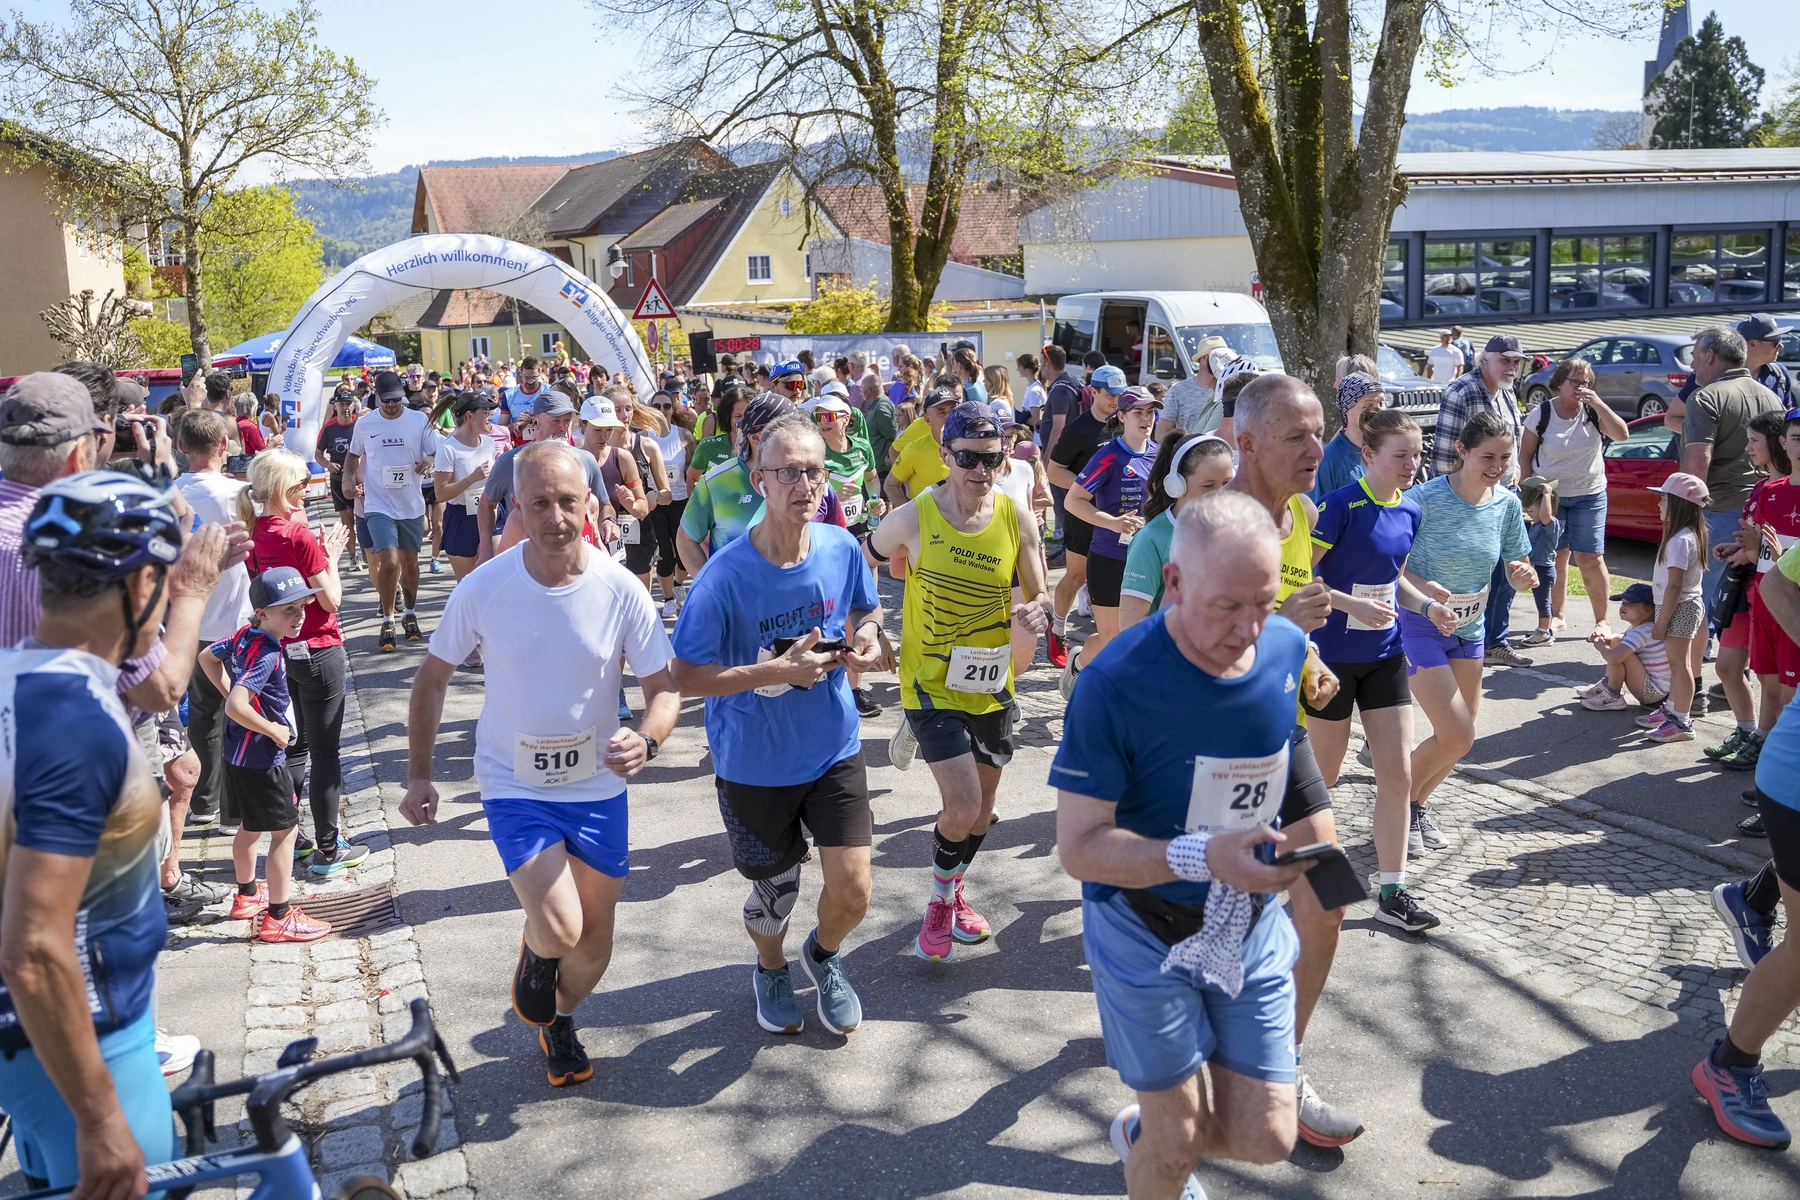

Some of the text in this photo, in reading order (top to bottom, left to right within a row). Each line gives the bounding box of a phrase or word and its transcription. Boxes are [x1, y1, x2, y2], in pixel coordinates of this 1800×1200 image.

[386, 249, 529, 277] Herzlich willkommen!
[592, 301, 623, 339] Volksbank
[294, 295, 357, 395] Allgäu-Oberschwaben eG
[283, 347, 303, 393] Volksbank
[786, 362, 801, 371] ITALIA
[392, 472, 404, 481] 72
[844, 505, 857, 517] 60
[1348, 499, 1368, 510] Kempa
[949, 546, 1002, 566] POLDI SPORT
[953, 556, 996, 573] Bad Waldsee
[1290, 566, 1309, 579] SPORT
[287, 577, 305, 587] FOX
[1453, 602, 1480, 619] 519
[759, 606, 805, 634] NIGHT
[760, 620, 805, 641] AUSTRIA
[963, 664, 999, 681] 210
[536, 736, 578, 744] Leiblachlauf
[540, 740, 587, 751] Hergensweiler
[534, 749, 579, 770] 510
[545, 769, 568, 777] Michael
[1211, 772, 1230, 780] TSV
[1229, 781, 1268, 810] 28
[1240, 812, 1255, 820] Dirk
